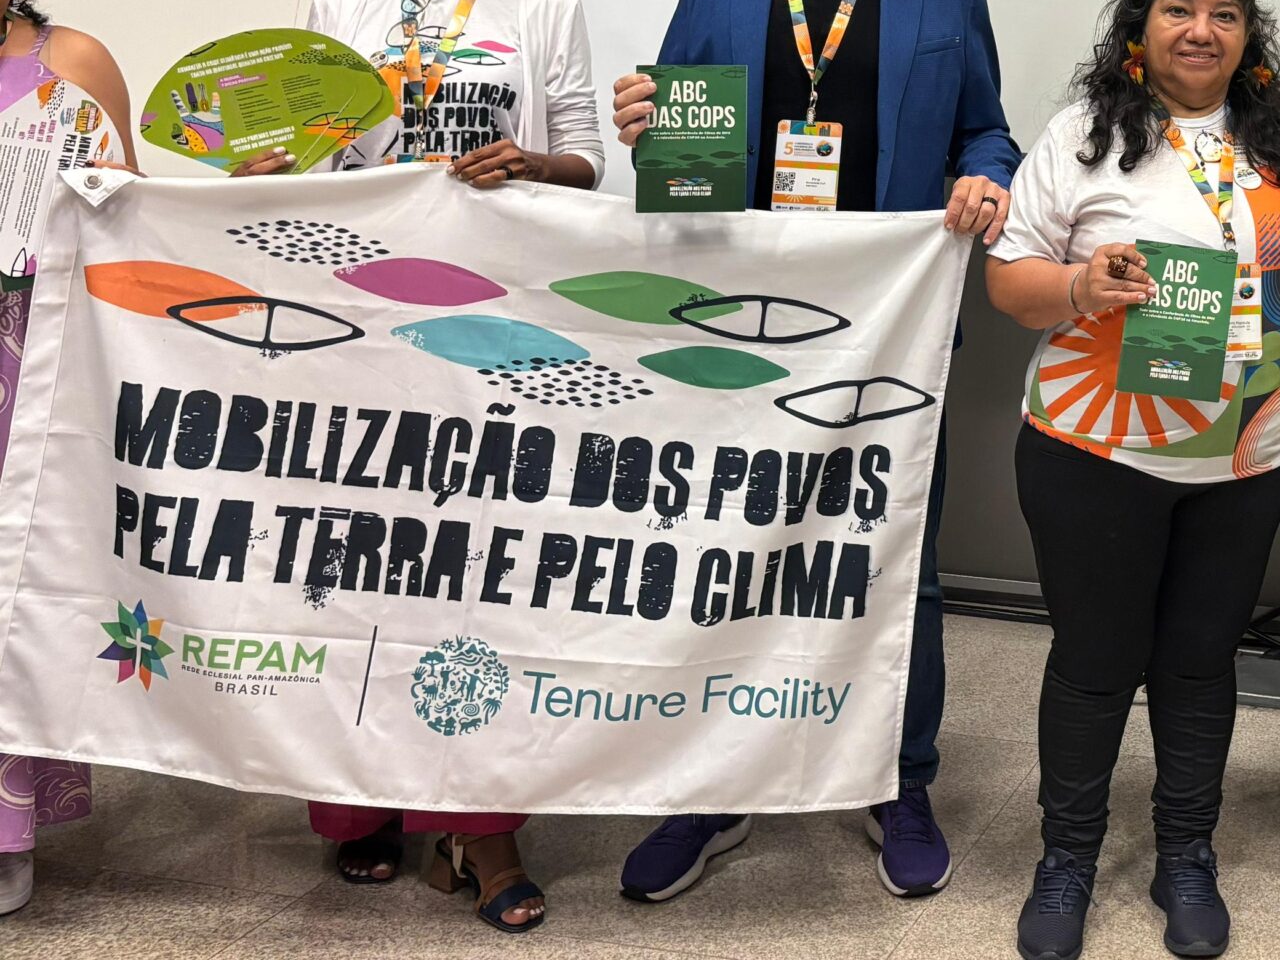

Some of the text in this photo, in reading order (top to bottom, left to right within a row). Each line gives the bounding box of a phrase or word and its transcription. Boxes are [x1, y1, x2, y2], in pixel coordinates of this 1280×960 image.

[403, 83, 517, 111] MBILIZAÇÃO
[669, 80, 707, 103] ABC
[645, 105, 735, 128] DAS COPS
[73, 136, 92, 169] MOBILIZ
[403, 130, 445, 153] PLA
[1162, 258, 1199, 285] ABC
[1148, 283, 1222, 314] AS COPS
[114, 381, 891, 528] MOBILIZAÇÃO DOS POVOS
[114, 482, 871, 627] PELA TERRA E PELO CLIMA
[182, 634, 328, 675] REPAM
[181, 664, 321, 684] REDE ECLESIAL PAN-AMAZÔNICA
[214, 681, 278, 696] BRASIL
[522, 670, 851, 725] Tenure Facility
